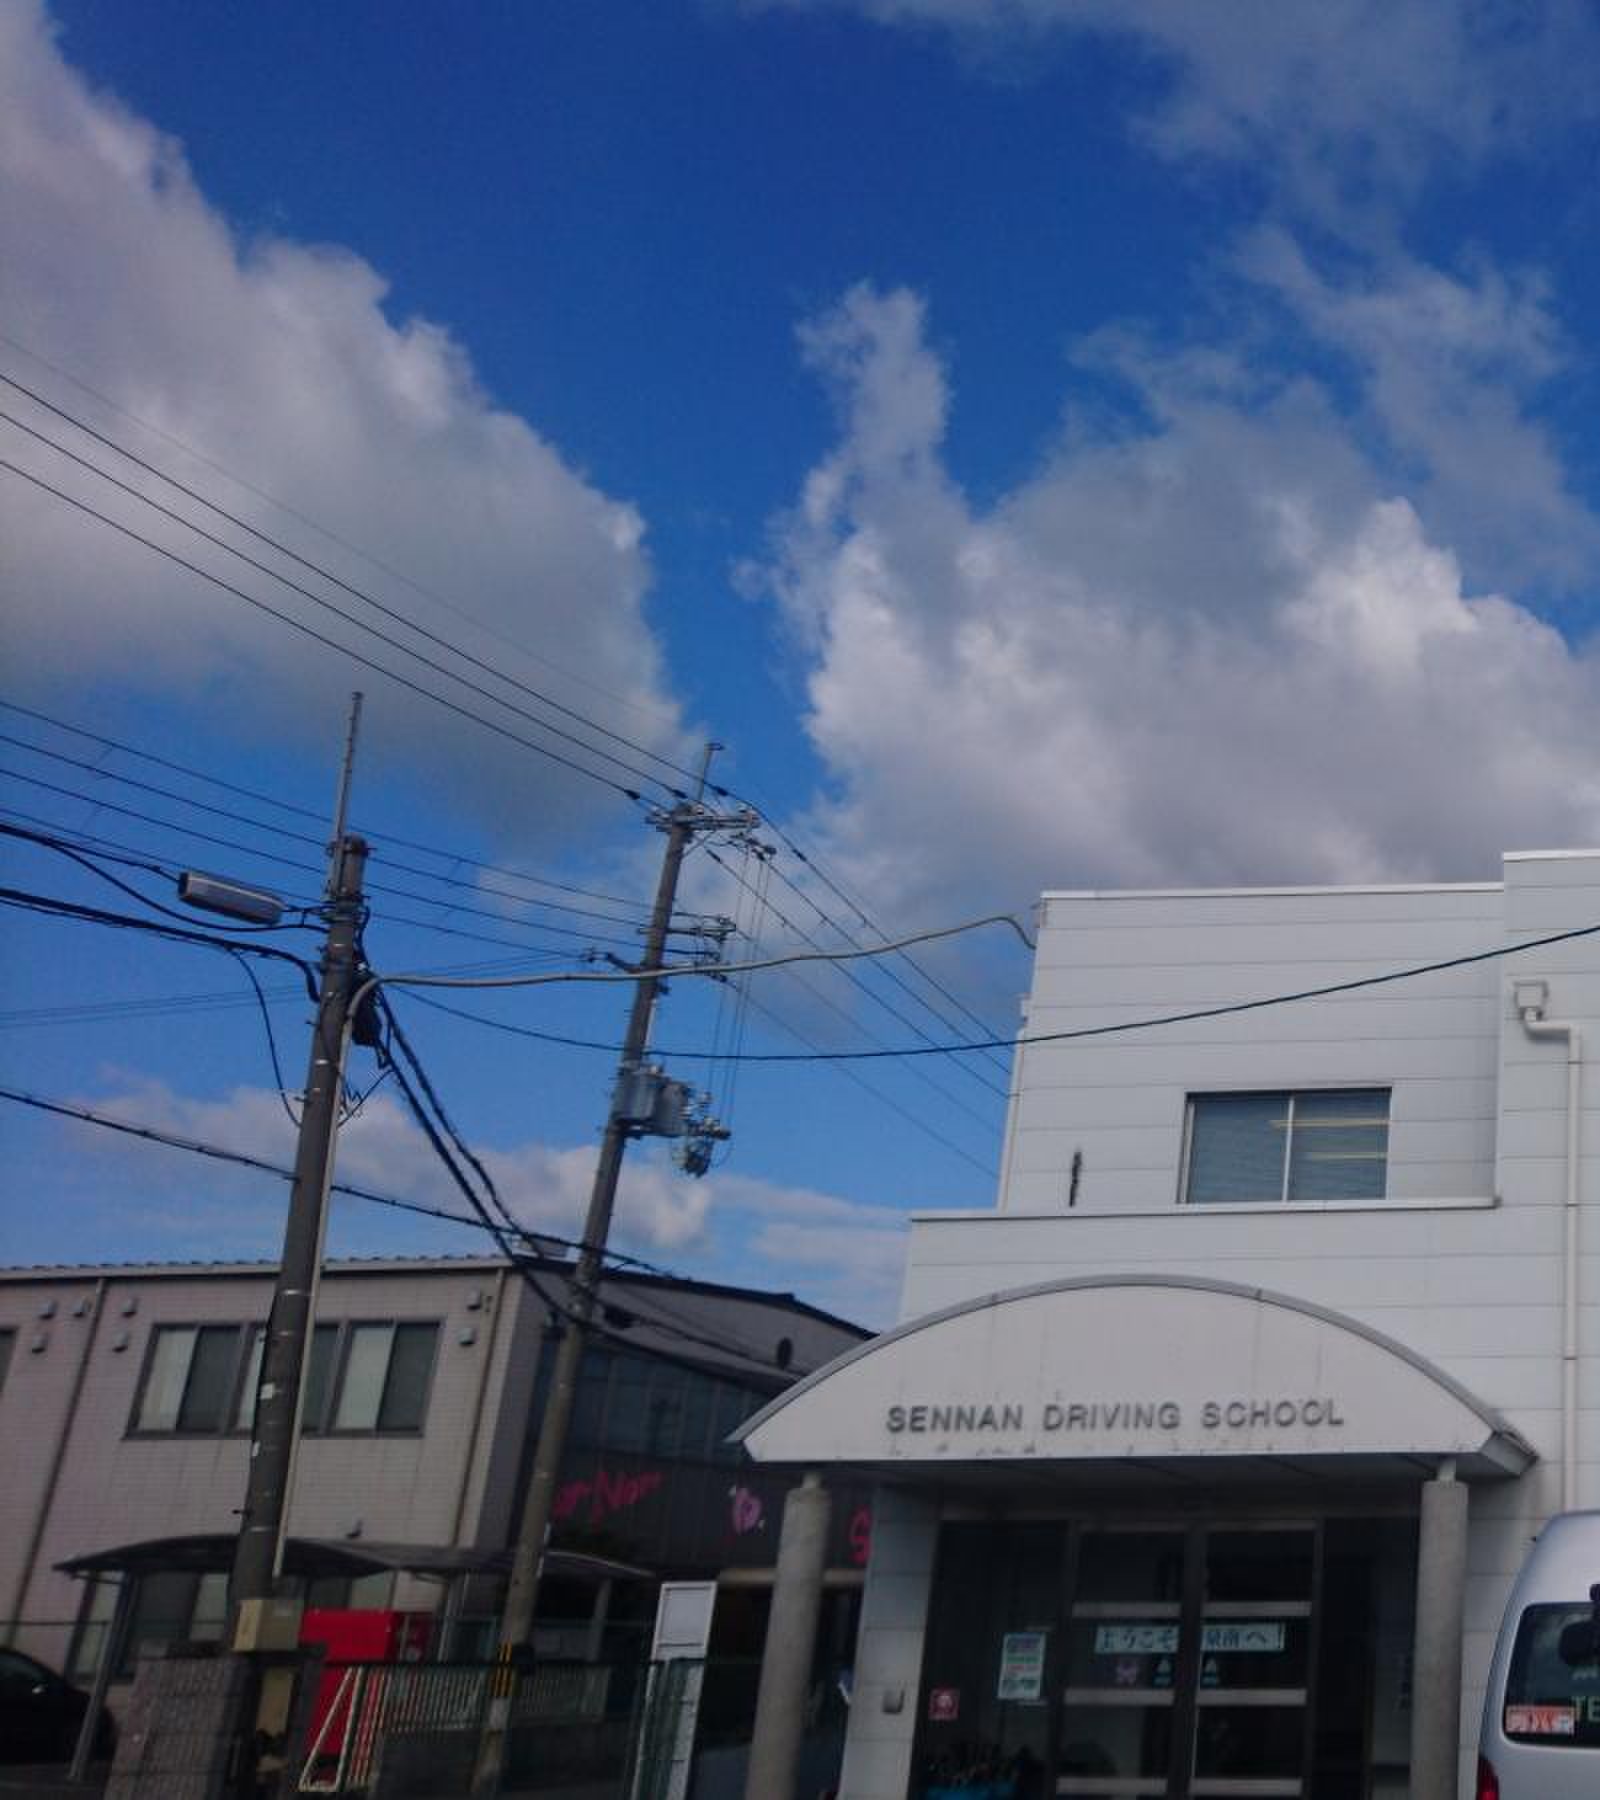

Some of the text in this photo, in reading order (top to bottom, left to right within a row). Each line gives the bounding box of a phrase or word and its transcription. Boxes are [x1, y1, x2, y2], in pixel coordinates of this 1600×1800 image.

[885, 1400, 1345, 1434] SENNAN DRIVING SCHOOL
